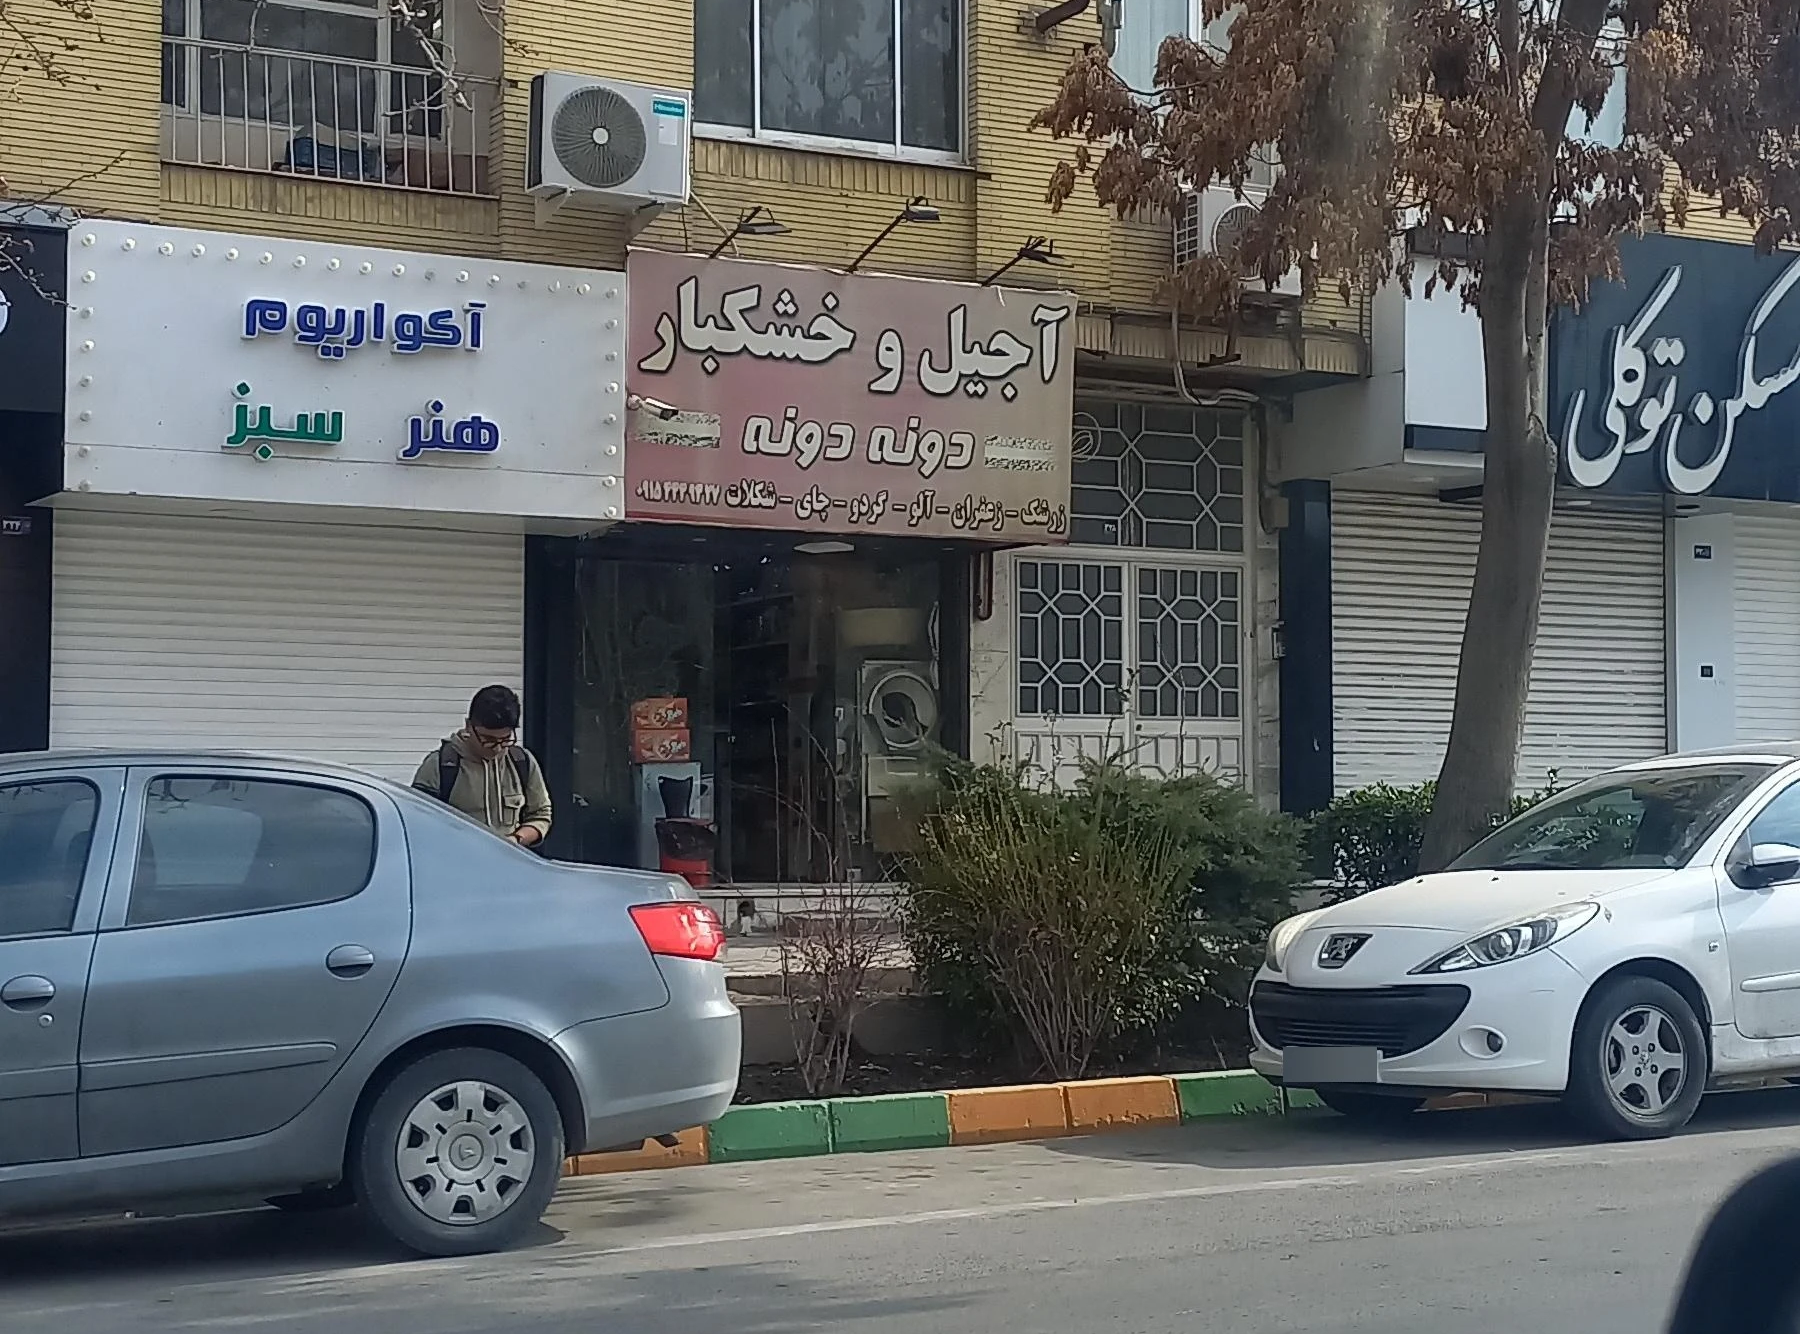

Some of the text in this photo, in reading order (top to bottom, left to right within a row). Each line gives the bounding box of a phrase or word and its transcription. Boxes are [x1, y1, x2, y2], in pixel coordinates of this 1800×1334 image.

[241, 296, 487, 359] آکواریوم
[638, 275, 1070, 401] آجیل و خشکبار
[1562, 265, 1686, 488] توکلی
[222, 382, 500, 462] هنر سبز
[742, 406, 855, 468] دونه
[867, 415, 975, 478] دونه
[725, 479, 776, 509] شکلات
[795, 484, 831, 522] چای
[849, 489, 888, 524] گردو
[908, 489, 935, 527] آلو
[951, 494, 1004, 531] زعفران
[1021, 498, 1066, 533] زرشک
